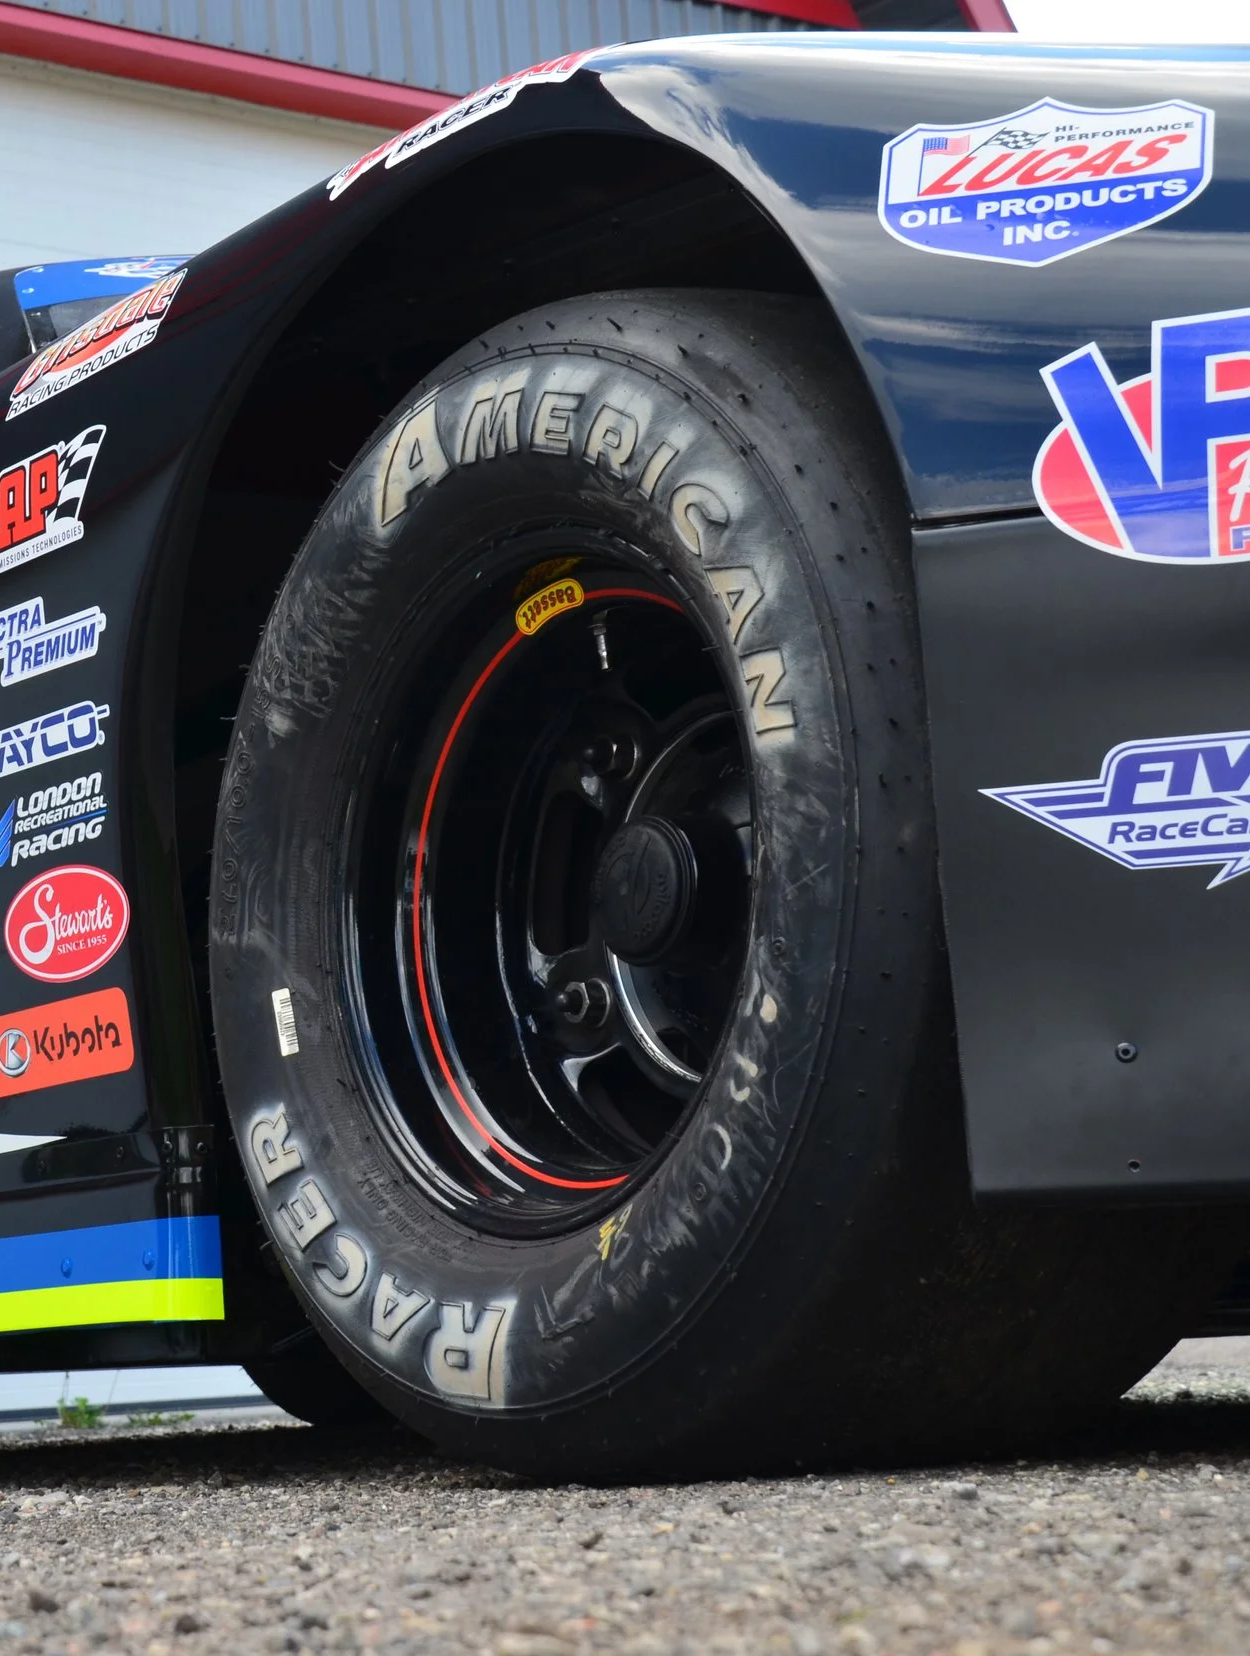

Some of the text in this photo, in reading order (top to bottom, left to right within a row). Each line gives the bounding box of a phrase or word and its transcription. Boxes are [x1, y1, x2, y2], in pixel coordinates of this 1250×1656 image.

[398, 87, 512, 152] RACER
[1054, 121, 1194, 143] PERFORMANCE
[918, 133, 1188, 197] LUCAS
[899, 178, 1188, 228] OIL PRODUCTS
[1002, 220, 1079, 246] INC.
[8, 324, 158, 417] RACING PRODUCTS
[31, 524, 83, 556] TECHNOLOGIES
[380, 386, 797, 735] AMERICAN
[522, 585, 577, 629] Bassett
[4, 622, 96, 678] PREMIUM
[17, 771, 102, 818] LONDON
[57, 935, 107, 955] SINCE 1955
[34, 1015, 122, 1062] Kubota
[250, 1101, 508, 1400] RACER
